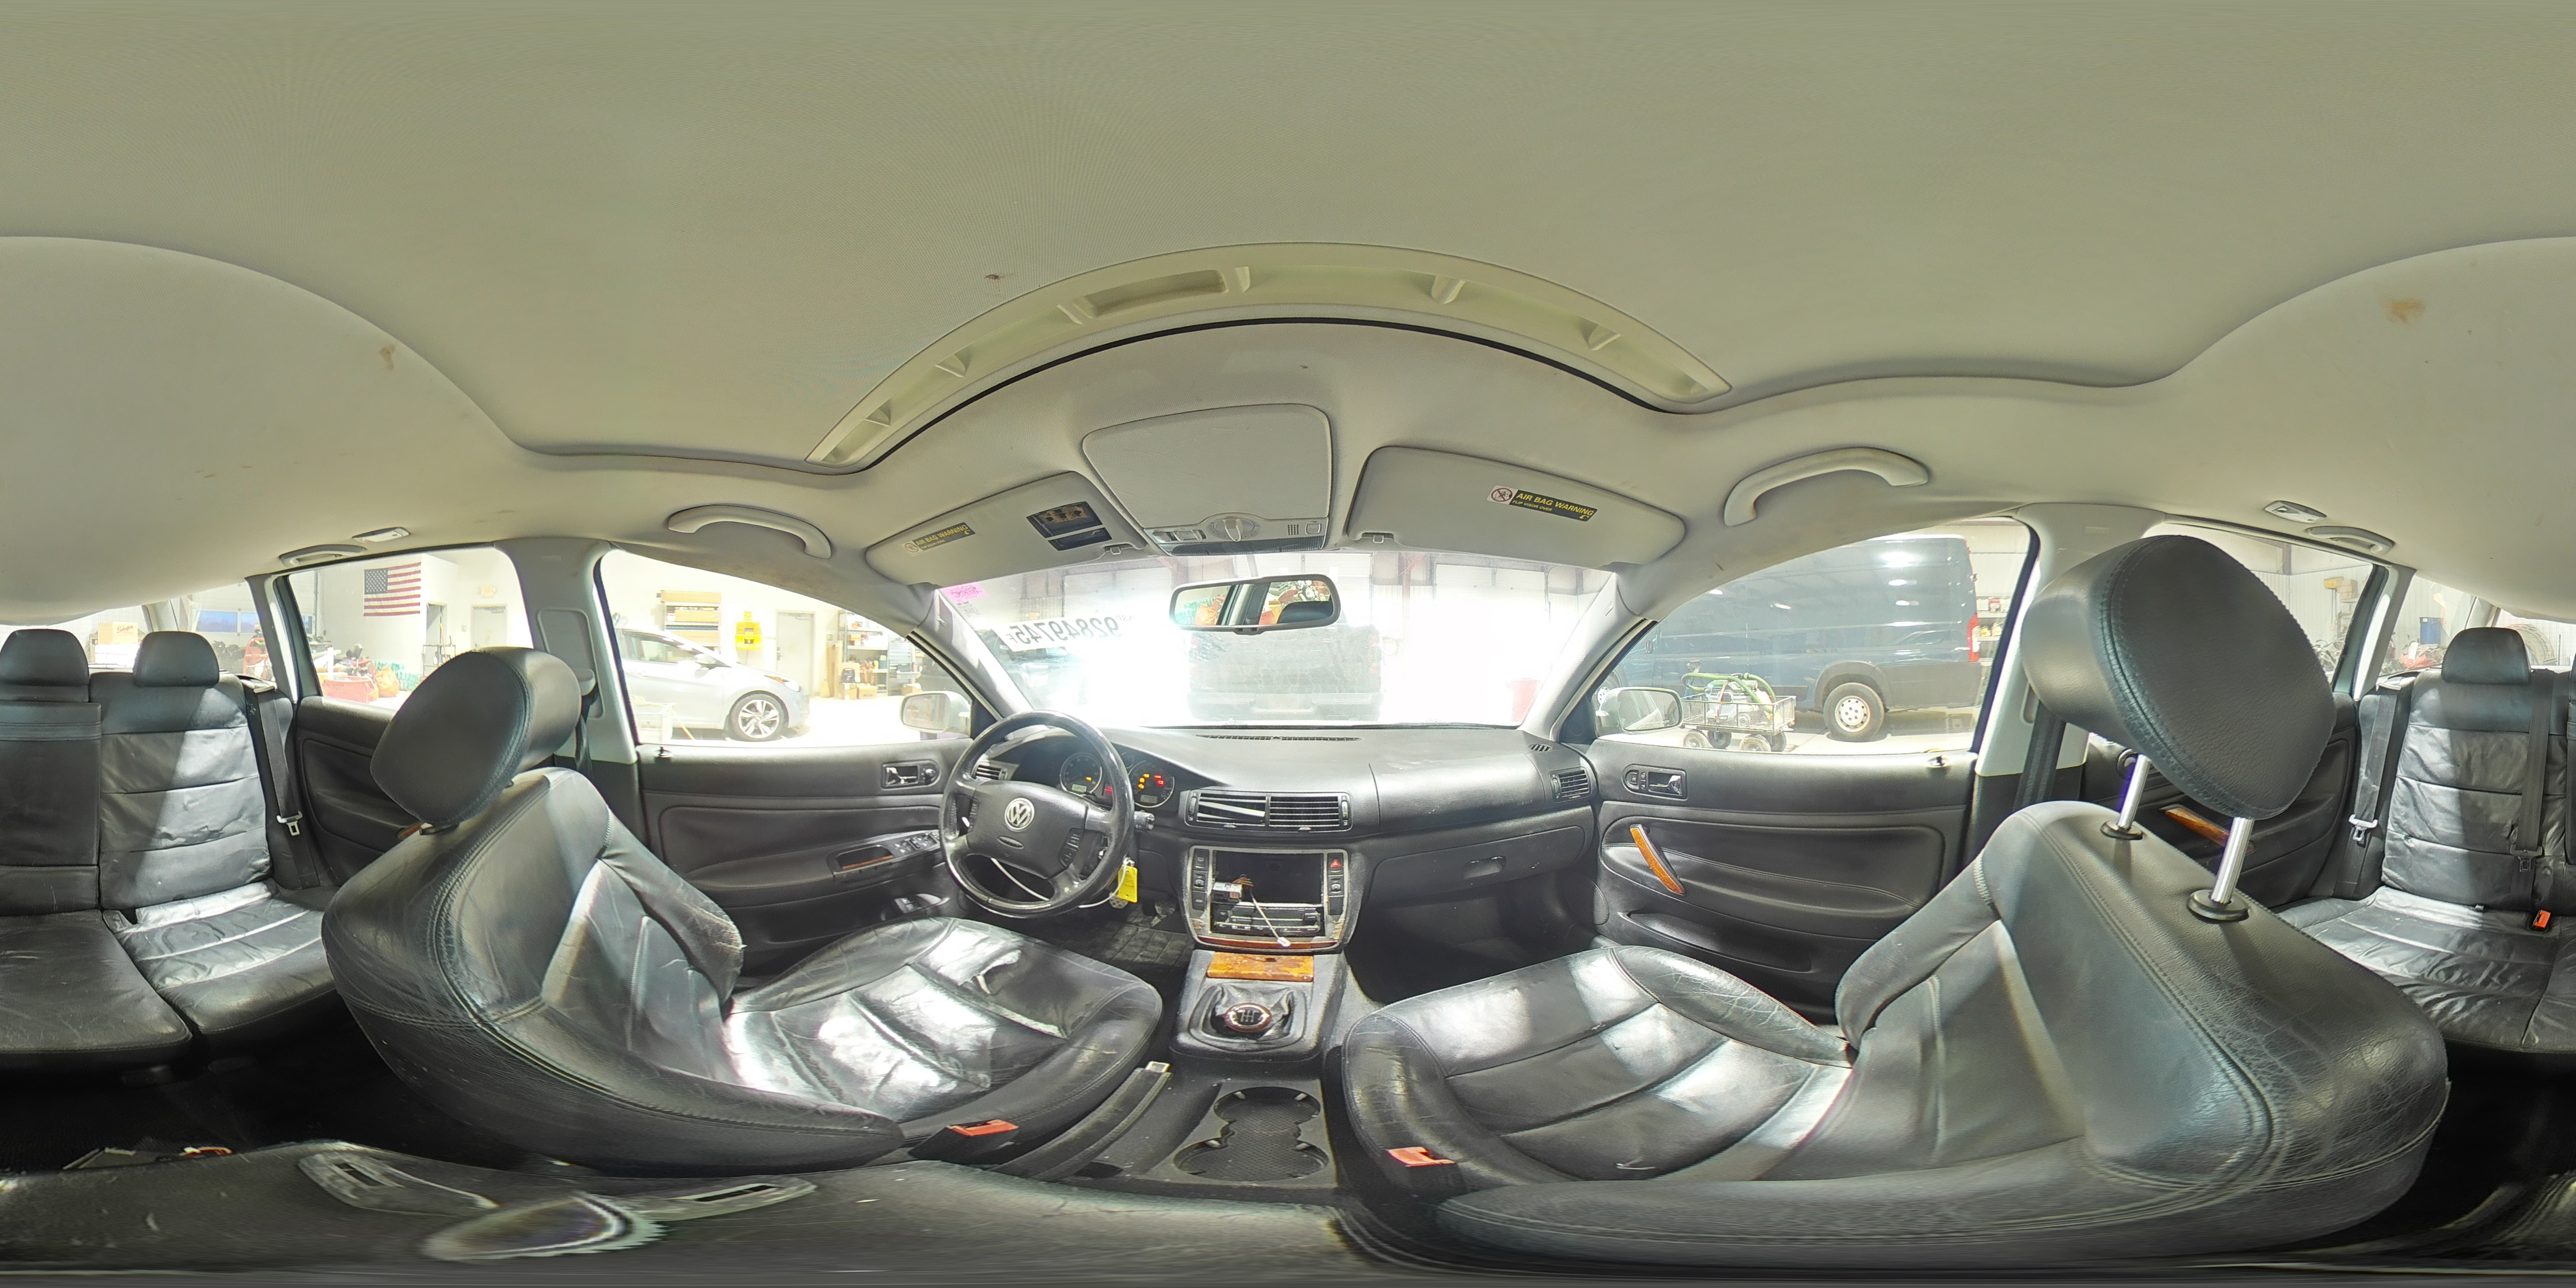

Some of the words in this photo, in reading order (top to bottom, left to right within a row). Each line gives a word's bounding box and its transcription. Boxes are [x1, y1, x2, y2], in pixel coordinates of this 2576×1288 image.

[1516, 493, 1533, 501] AIR
[1533, 497, 1553, 506] BAG
[1554, 501, 1594, 516] WARNING
[937, 525, 968, 538] WARNING
[1007, 802, 1031, 827] VW
